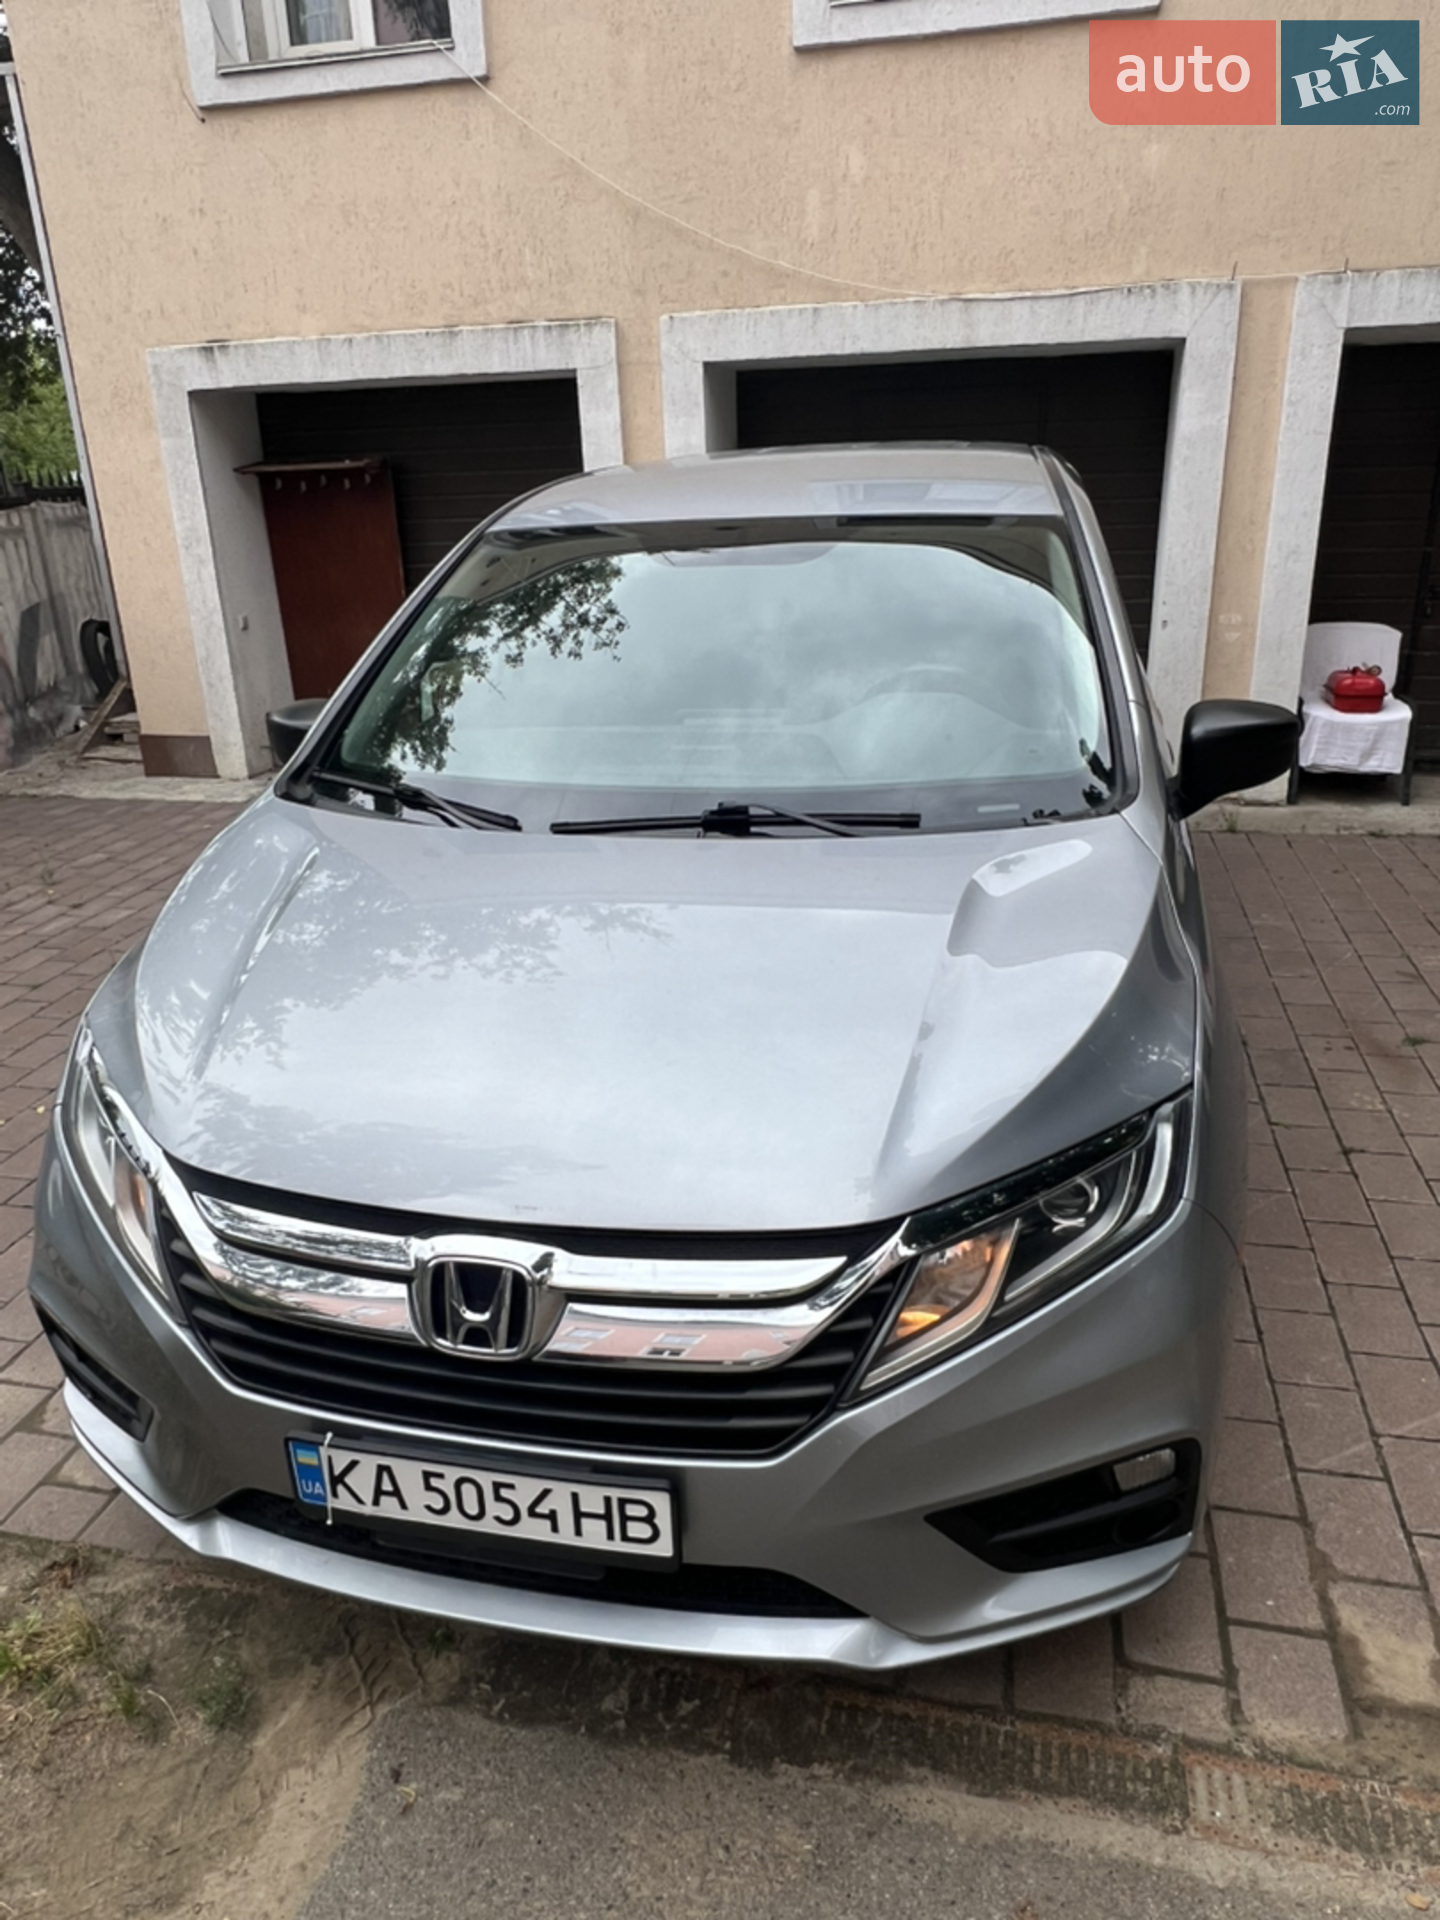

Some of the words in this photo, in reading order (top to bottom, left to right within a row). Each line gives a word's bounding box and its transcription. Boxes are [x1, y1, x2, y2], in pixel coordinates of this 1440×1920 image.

[301, 1479, 325, 1498] UA
[327, 1454, 408, 1511] KA
[421, 1469, 560, 1535] 5054
[570, 1491, 662, 1545] HB
